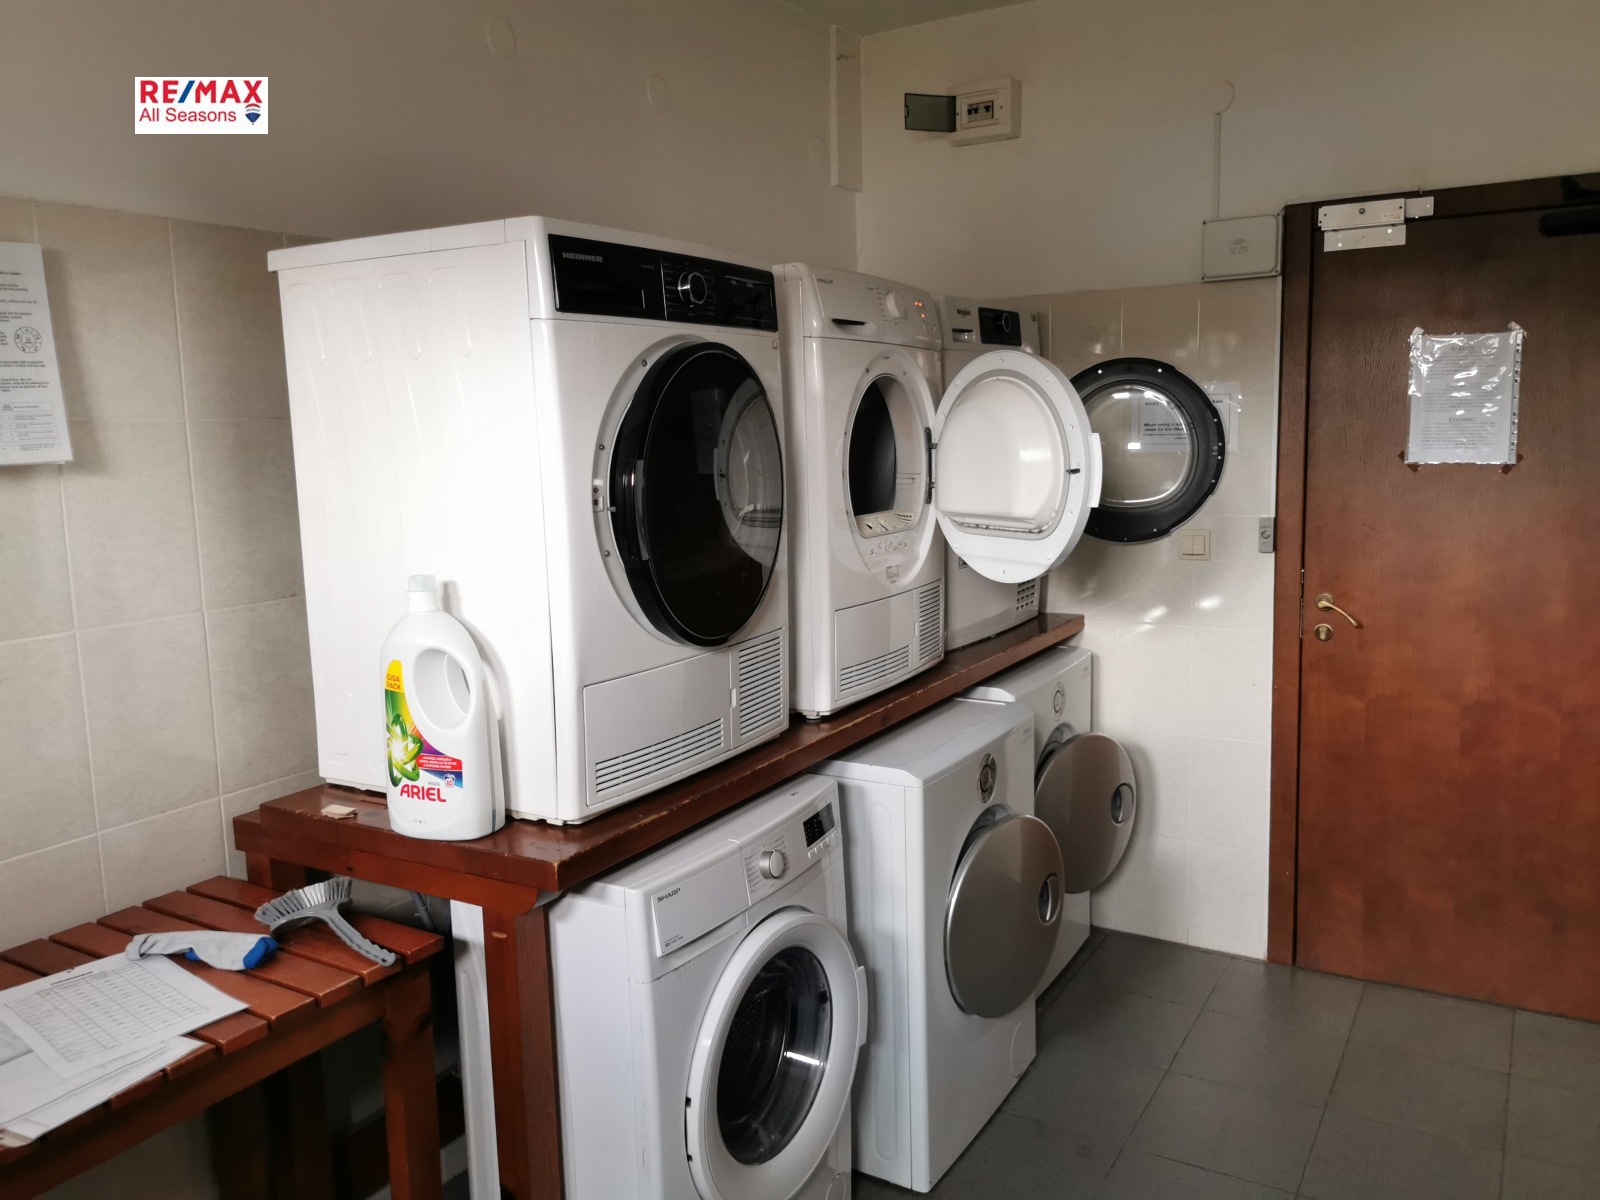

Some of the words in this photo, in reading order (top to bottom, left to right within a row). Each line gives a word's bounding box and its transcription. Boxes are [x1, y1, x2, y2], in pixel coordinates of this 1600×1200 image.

[386, 673, 400, 682] GIGA
[386, 681, 401, 691] PACK
[400, 784, 447, 803] ARIEL
[657, 887, 681, 903] SHARP
